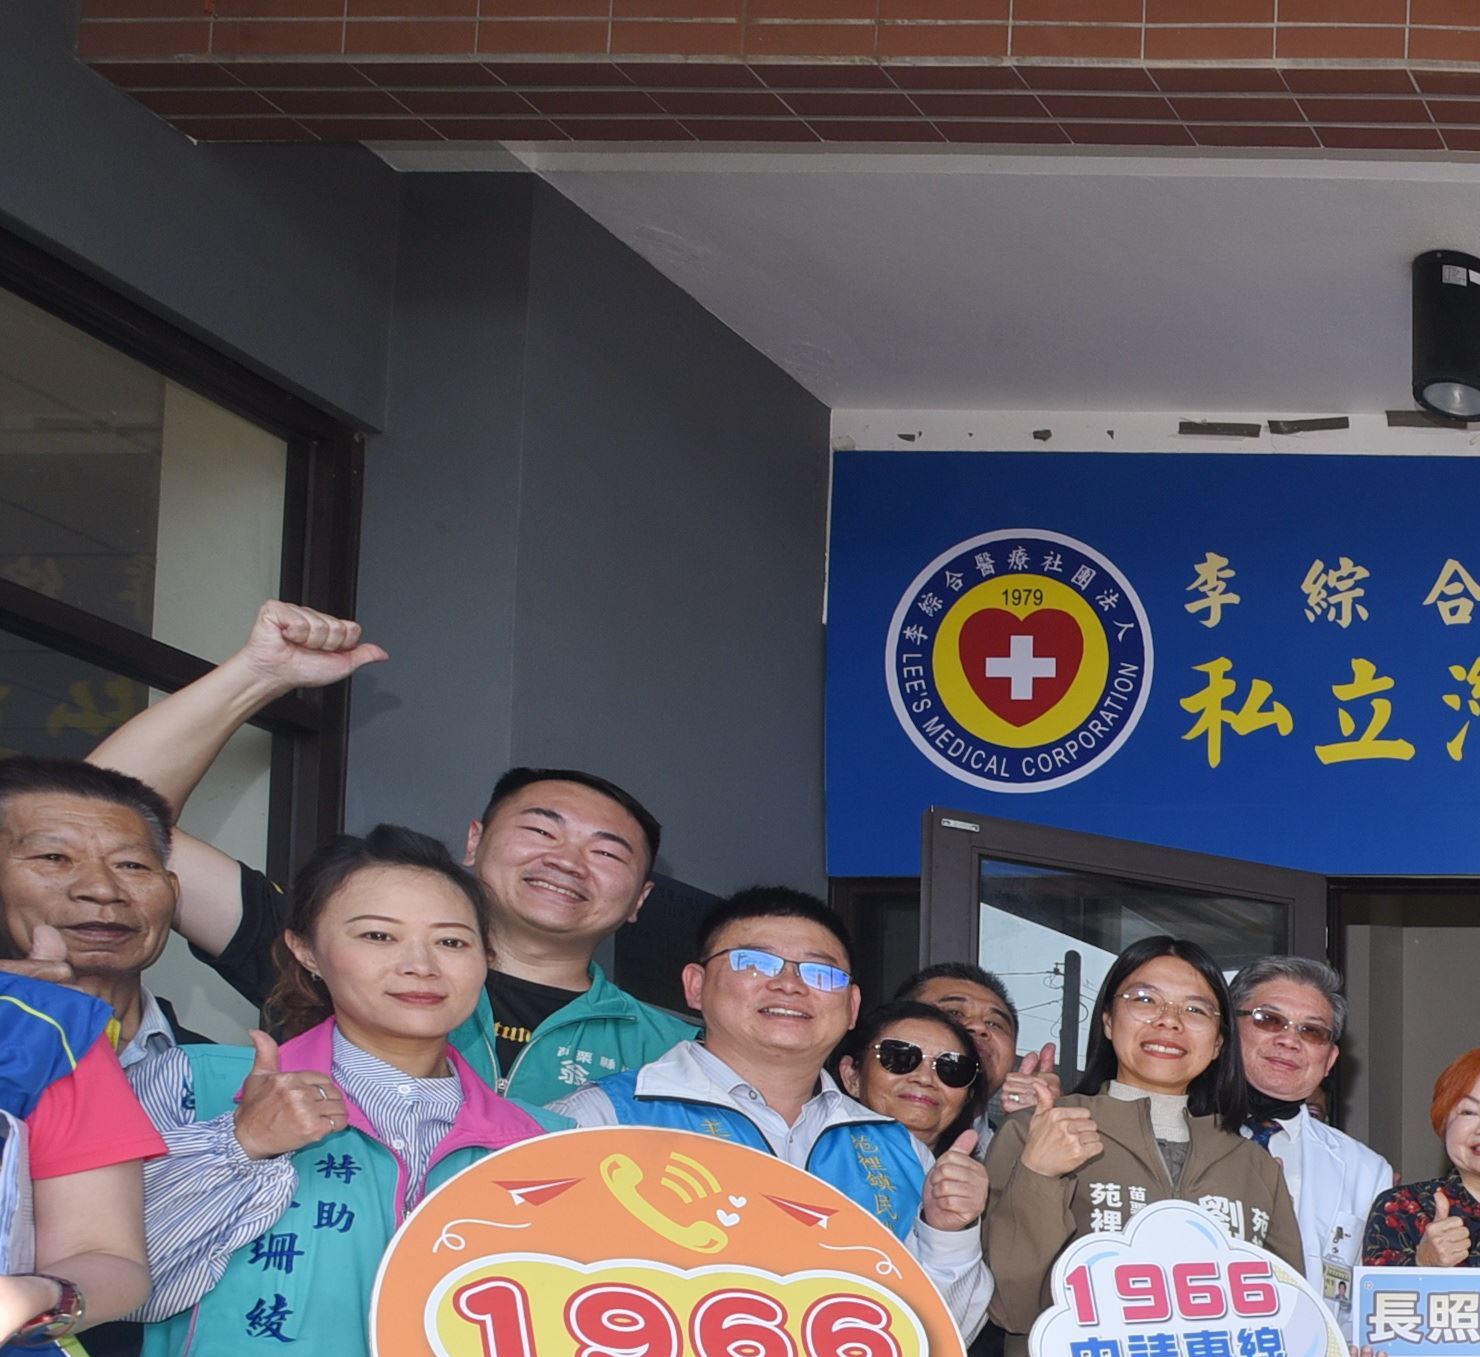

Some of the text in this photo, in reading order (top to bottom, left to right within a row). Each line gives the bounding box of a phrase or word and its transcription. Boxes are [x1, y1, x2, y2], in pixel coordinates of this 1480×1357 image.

[902, 545, 1135, 646] 李綜合醫療社團法人
[1002, 588, 1044, 606] 1979
[902, 653, 1140, 778] LEE'S MEDICAL CORPORATION
[314, 1152, 363, 1234] 特助
[1089, 1182, 1123, 1233] 苑裡
[245, 1200, 305, 1344] 珊綾
[1064, 1259, 1280, 1326] 1966
